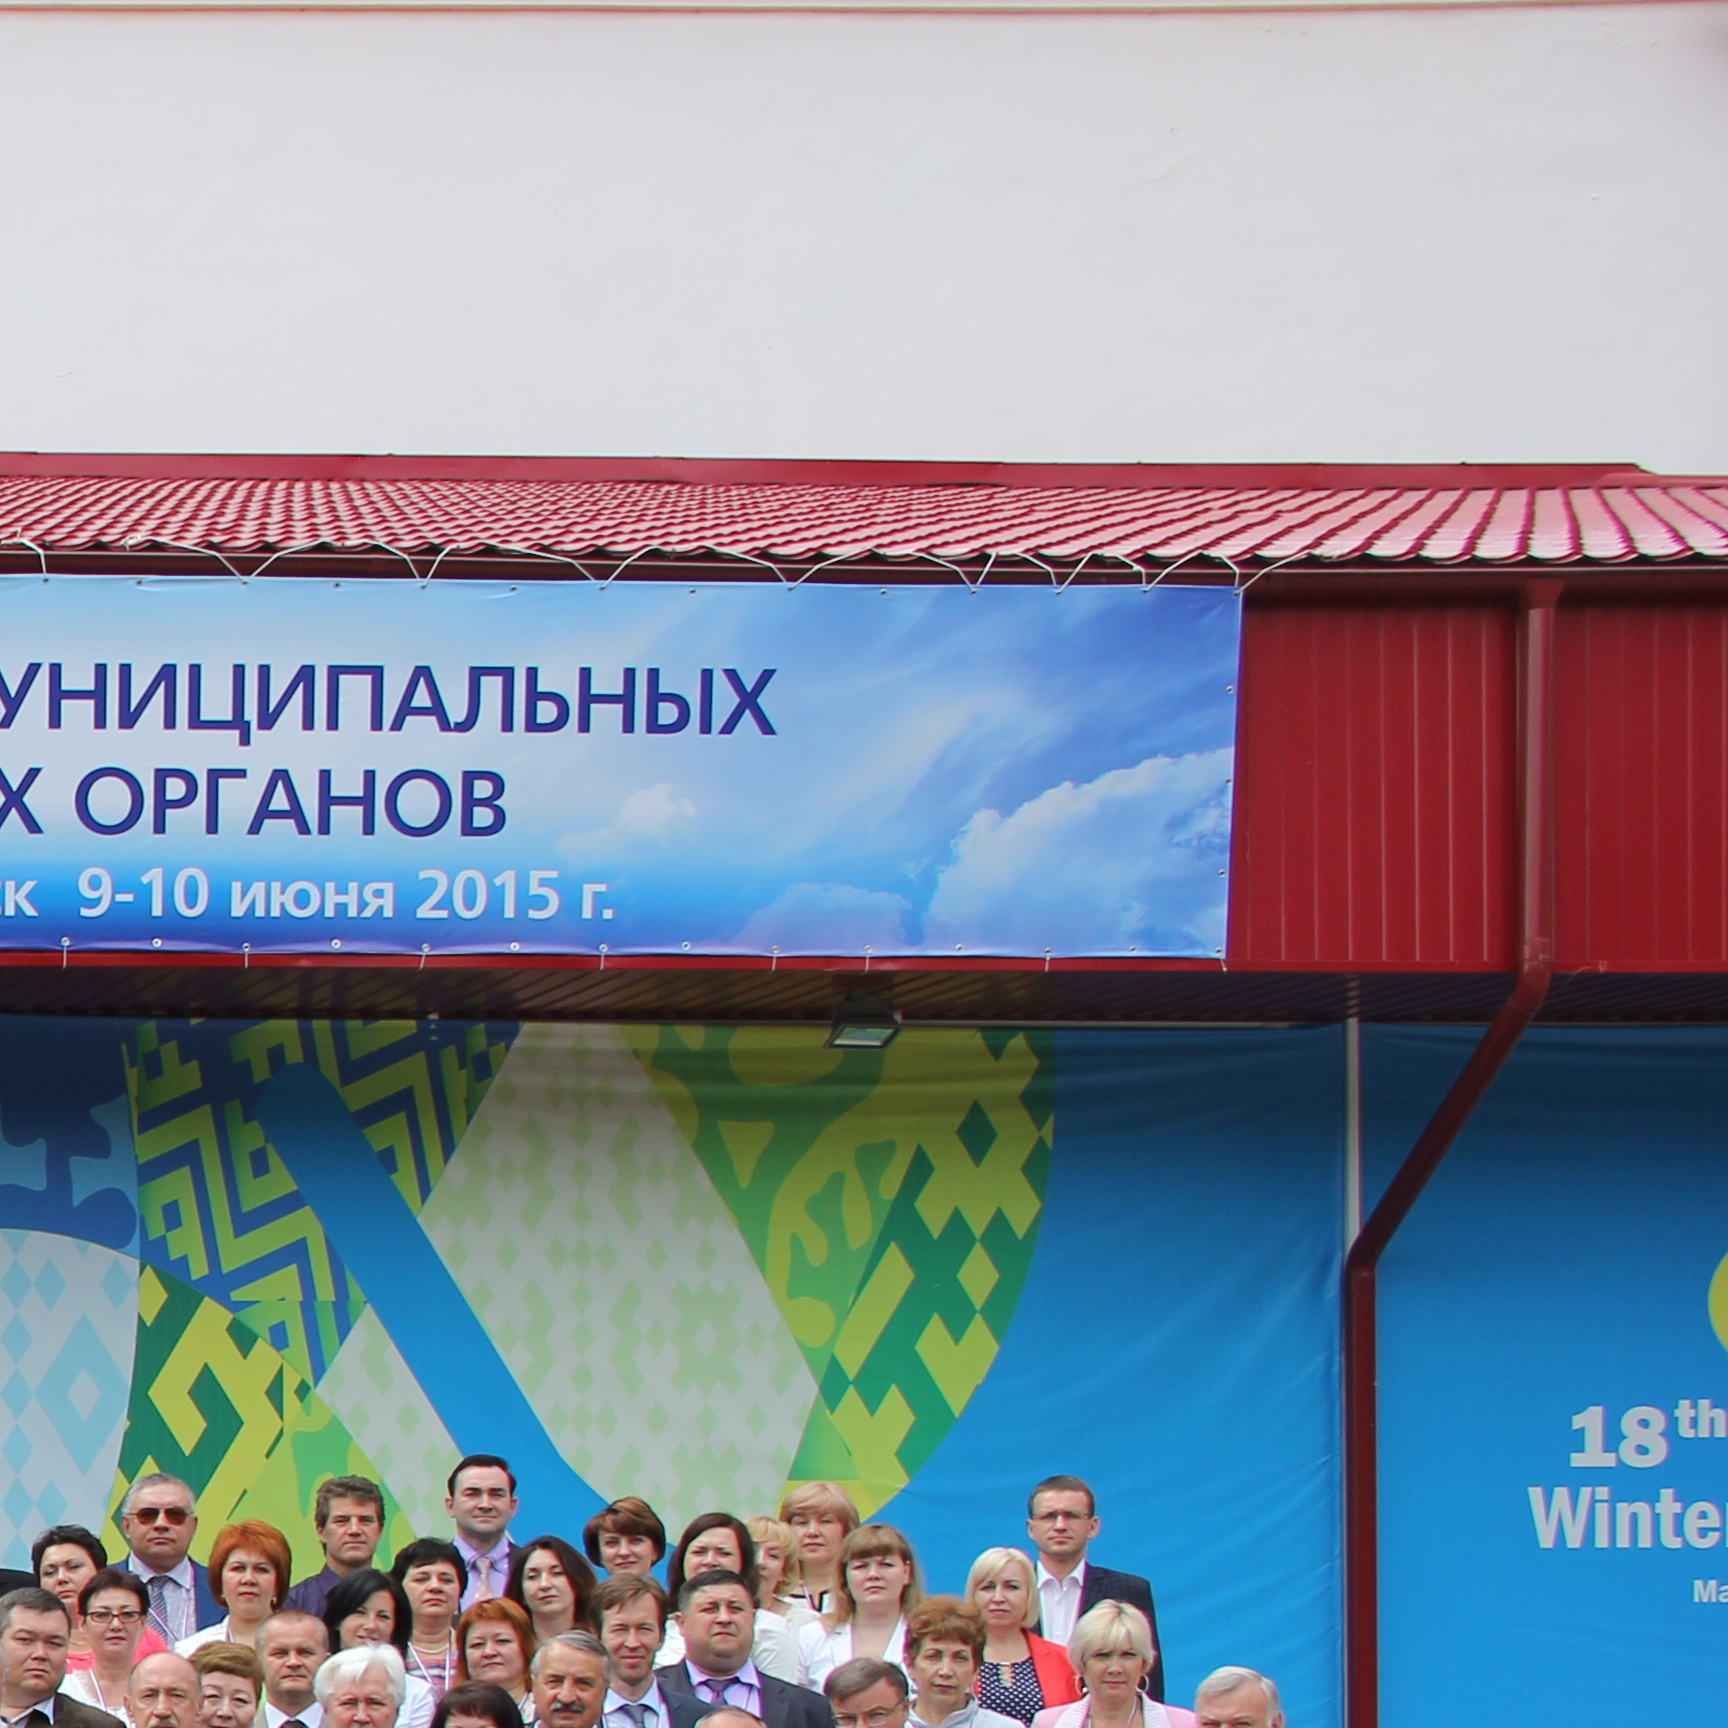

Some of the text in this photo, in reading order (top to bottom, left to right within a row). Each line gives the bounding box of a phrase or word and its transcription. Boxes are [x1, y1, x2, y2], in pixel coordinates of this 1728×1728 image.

[74, 766, 507, 839] ОРГАНОВ
[77, 865, 211, 918] 9-10
[230, 880, 395, 919] июня
[415, 867, 561, 920] 2015
[582, 882, 615, 920] г.
[1527, 1486, 1728, 1549] Winte
